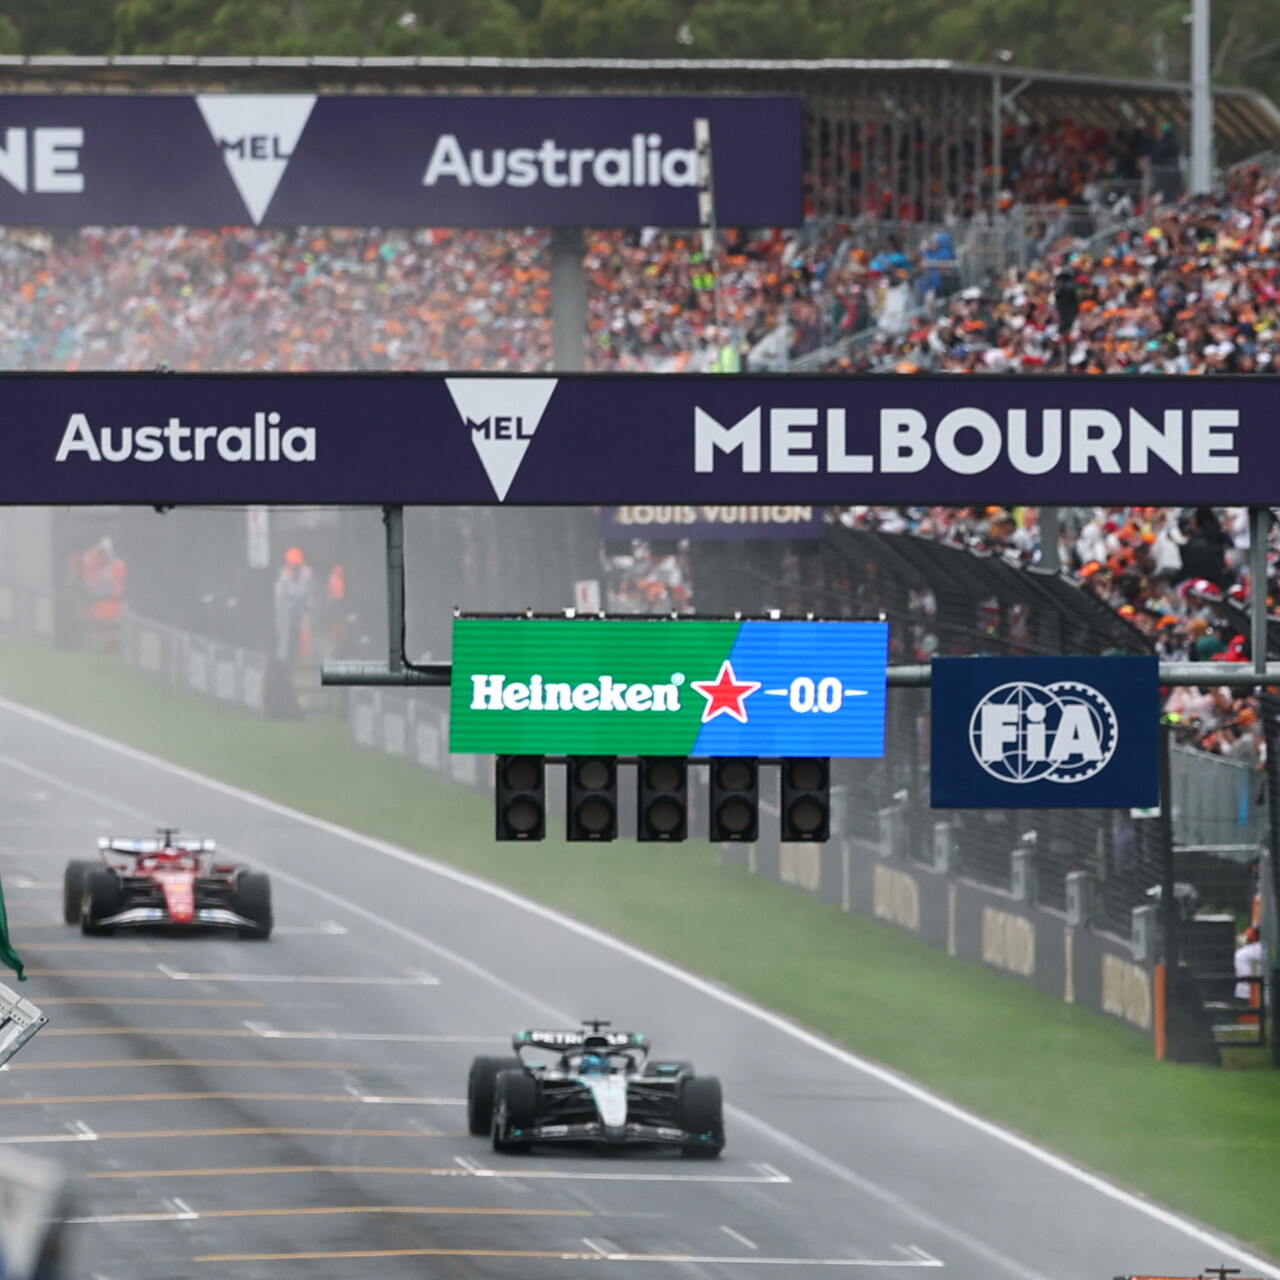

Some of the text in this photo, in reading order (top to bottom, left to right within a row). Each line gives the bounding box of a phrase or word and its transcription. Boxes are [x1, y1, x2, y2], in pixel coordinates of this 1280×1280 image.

[219, 134, 291, 158] MEL
[424, 134, 698, 186] Australia
[55, 412, 316, 462] Australia
[466, 416, 533, 440] MEL
[694, 406, 1240, 476] MELBOURNE
[617, 505, 698, 525] LOUIS
[470, 674, 682, 712] Heineken
[531, 1030, 629, 1045] PETRAS
